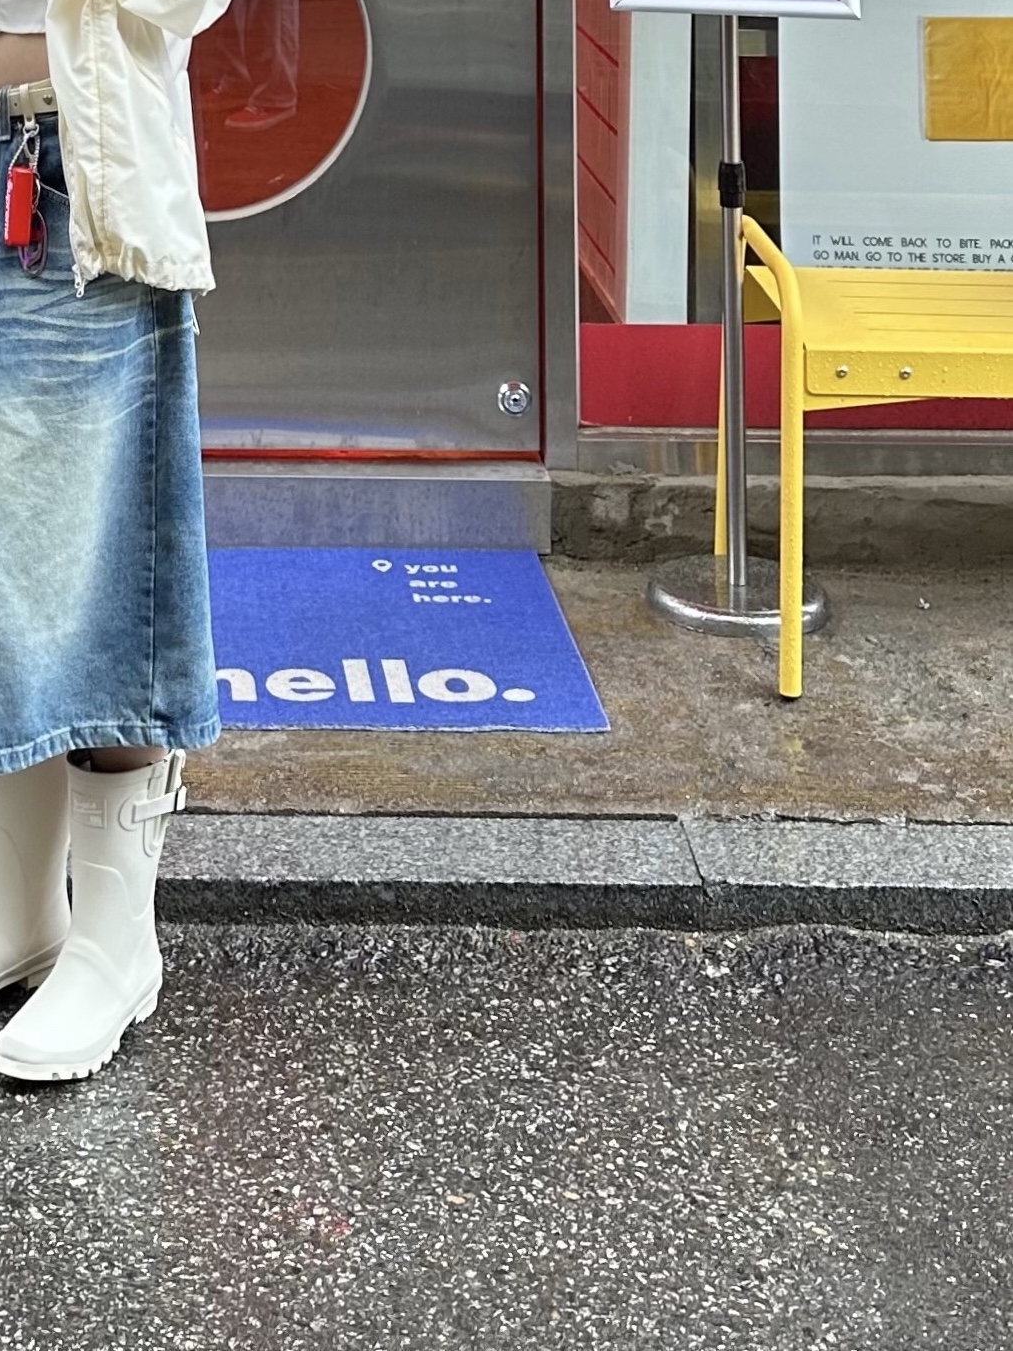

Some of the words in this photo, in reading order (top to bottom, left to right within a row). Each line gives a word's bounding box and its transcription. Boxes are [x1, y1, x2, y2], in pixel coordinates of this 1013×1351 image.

[812, 235, 821, 245] IT
[830, 236, 854, 246] WILL
[862, 236, 893, 247] COME
[901, 237, 927, 248] BACK
[936, 238, 951, 248] TO
[813, 250, 829, 260] GO
[865, 251, 881, 262] GO
[887, 252, 902, 262] TO
[908, 252, 927, 263] THE
[972, 254, 992, 264] BUY
[998, 254, 1006, 265] A
[404, 562, 458, 576] you
[409, 579, 458, 589] are
[412, 592, 492, 605] here.
